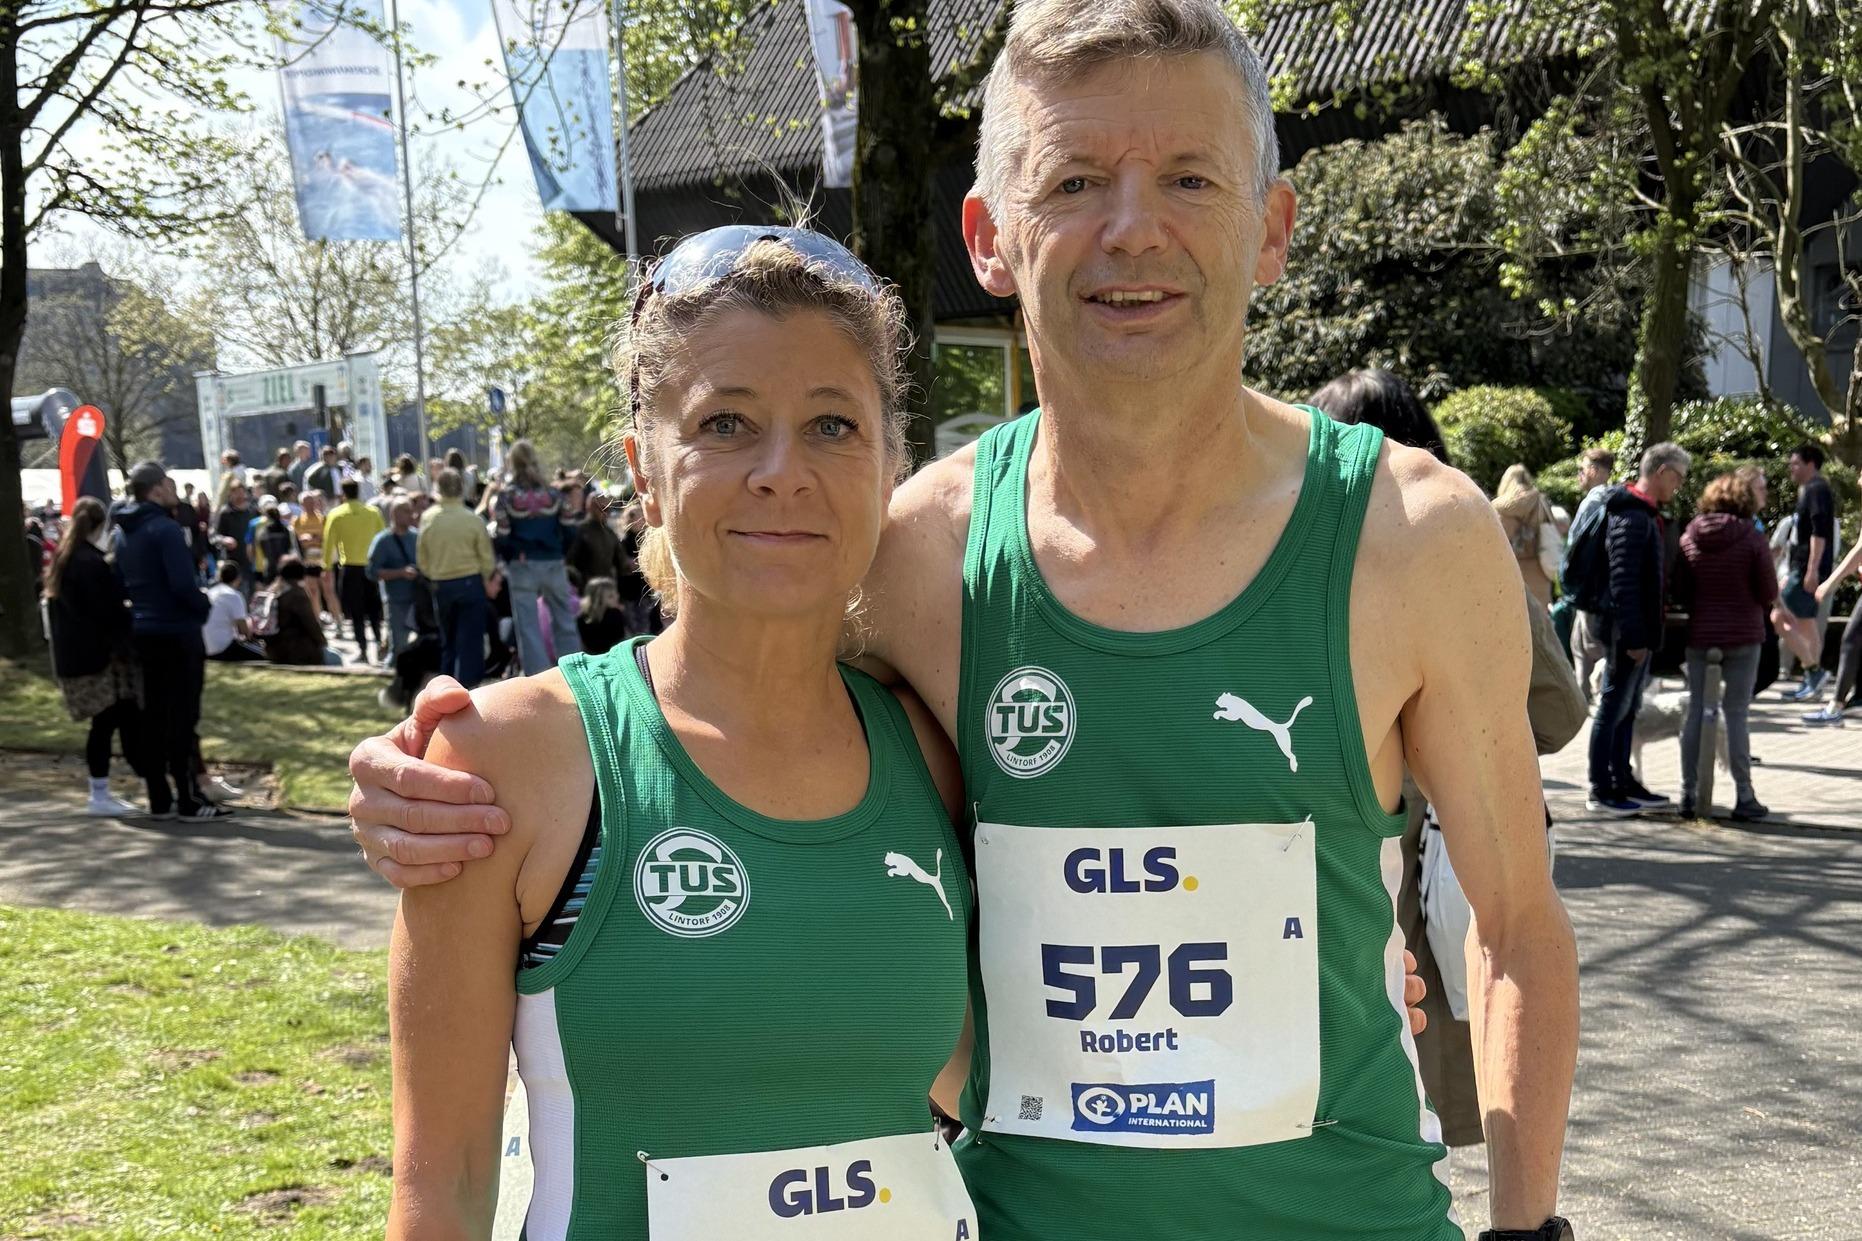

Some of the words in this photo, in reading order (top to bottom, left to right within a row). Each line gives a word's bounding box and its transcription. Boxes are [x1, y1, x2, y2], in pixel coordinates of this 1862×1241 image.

[263, 373, 295, 405] ZIEL
[996, 705, 1064, 734] TUS
[1006, 753, 1037, 767] LINTORF
[1039, 744, 1056, 761] 1908
[649, 864, 738, 894] TUS
[668, 912, 710, 926] LINTORF
[712, 904, 731, 921] 1908
[1283, 917, 1304, 940] A
[1041, 942, 1233, 1022] 576
[1080, 1027, 1179, 1053] Robert
[1128, 1092, 1208, 1116] PLAN
[1128, 1117, 1208, 1128] INTERNATIONAL
[505, 1136, 521, 1157] A
[955, 1218, 970, 1241] A
